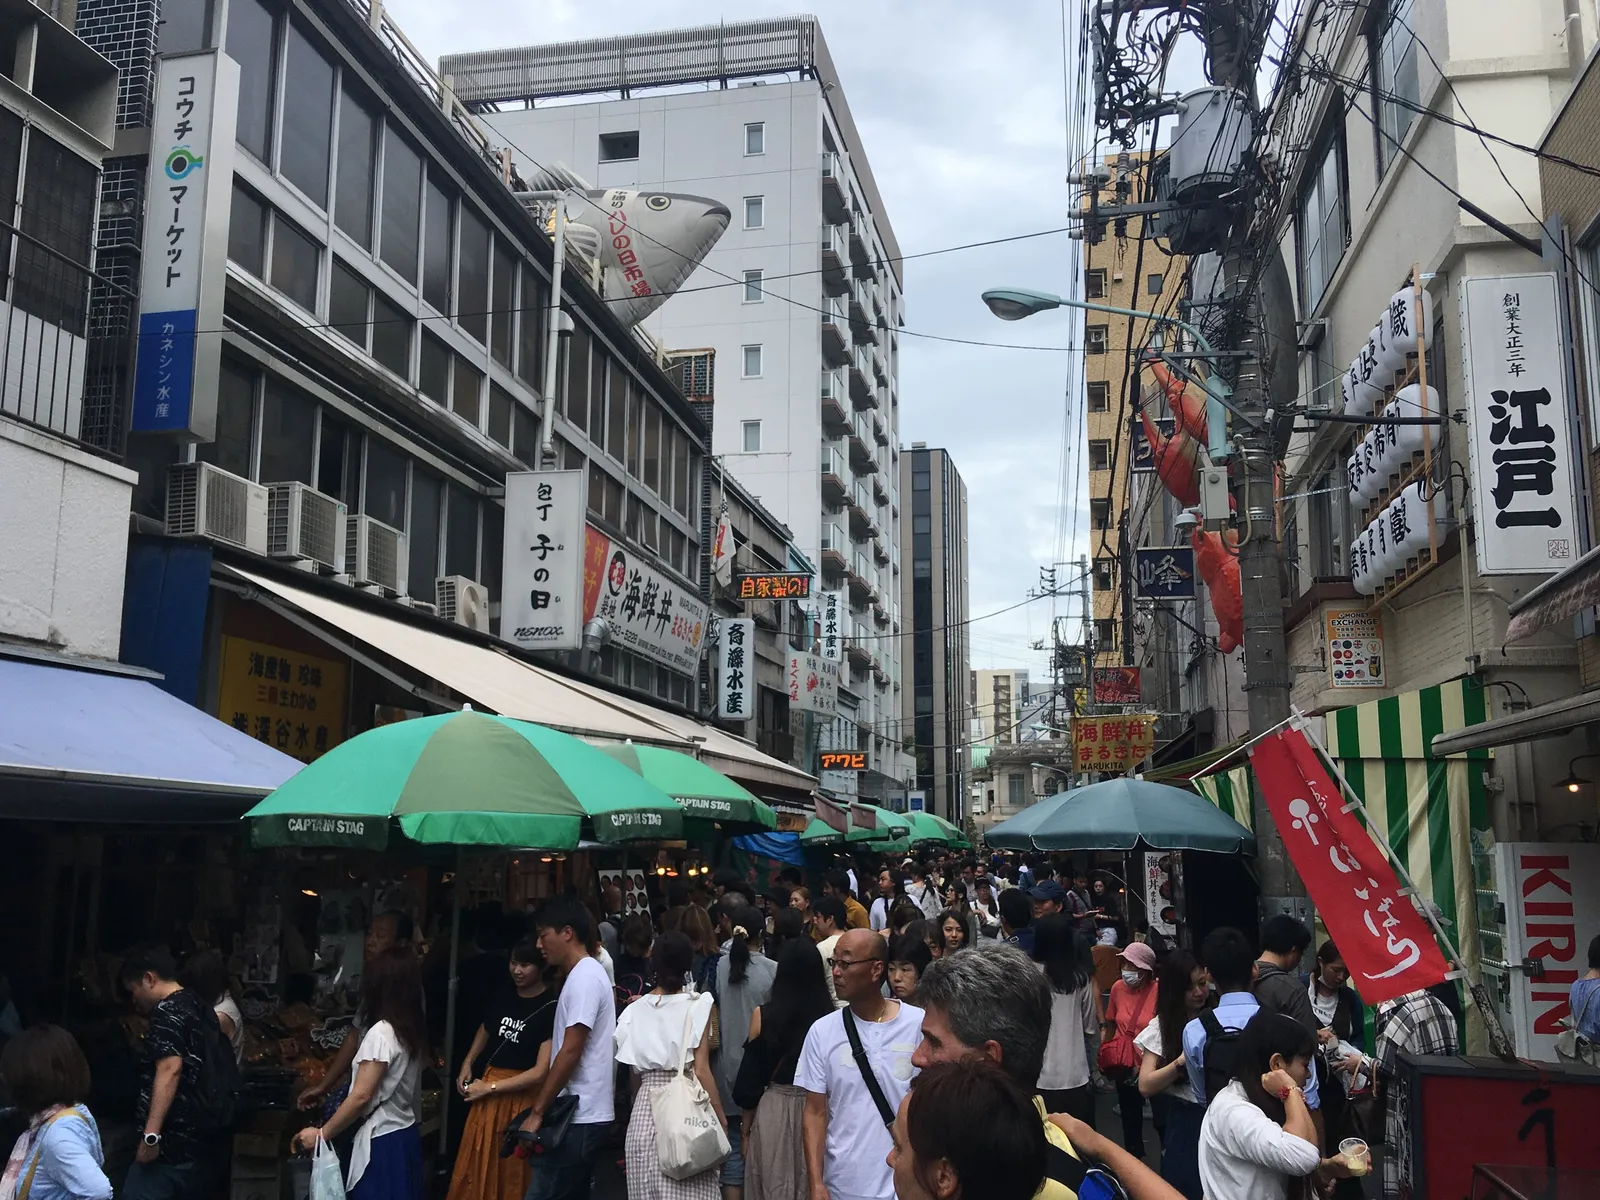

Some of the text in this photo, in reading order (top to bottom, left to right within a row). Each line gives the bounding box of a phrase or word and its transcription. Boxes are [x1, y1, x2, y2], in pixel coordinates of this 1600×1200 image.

[165, 76, 195, 288] コウチ マーケット
[1502, 292, 1527, 378] 創業大正三年
[154, 322, 175, 418] カネシン水産
[1487, 387, 1563, 529] 江戸一
[530, 482, 556, 610] 包丁 子の日
[620, 568, 673, 639] 海鮮丼
[741, 576, 801, 597] 自家製の
[1077, 720, 1145, 742] 海鮮丼
[1079, 744, 1146, 761] まるきた
[821, 753, 864, 768] アワビ
[1080, 761, 1124, 771] MARUKITA
[287, 818, 365, 835] CAPTAIN STAG
[674, 797, 731, 811] CAPTAIN STAG
[1520, 855, 1579, 1035] KIRIN
